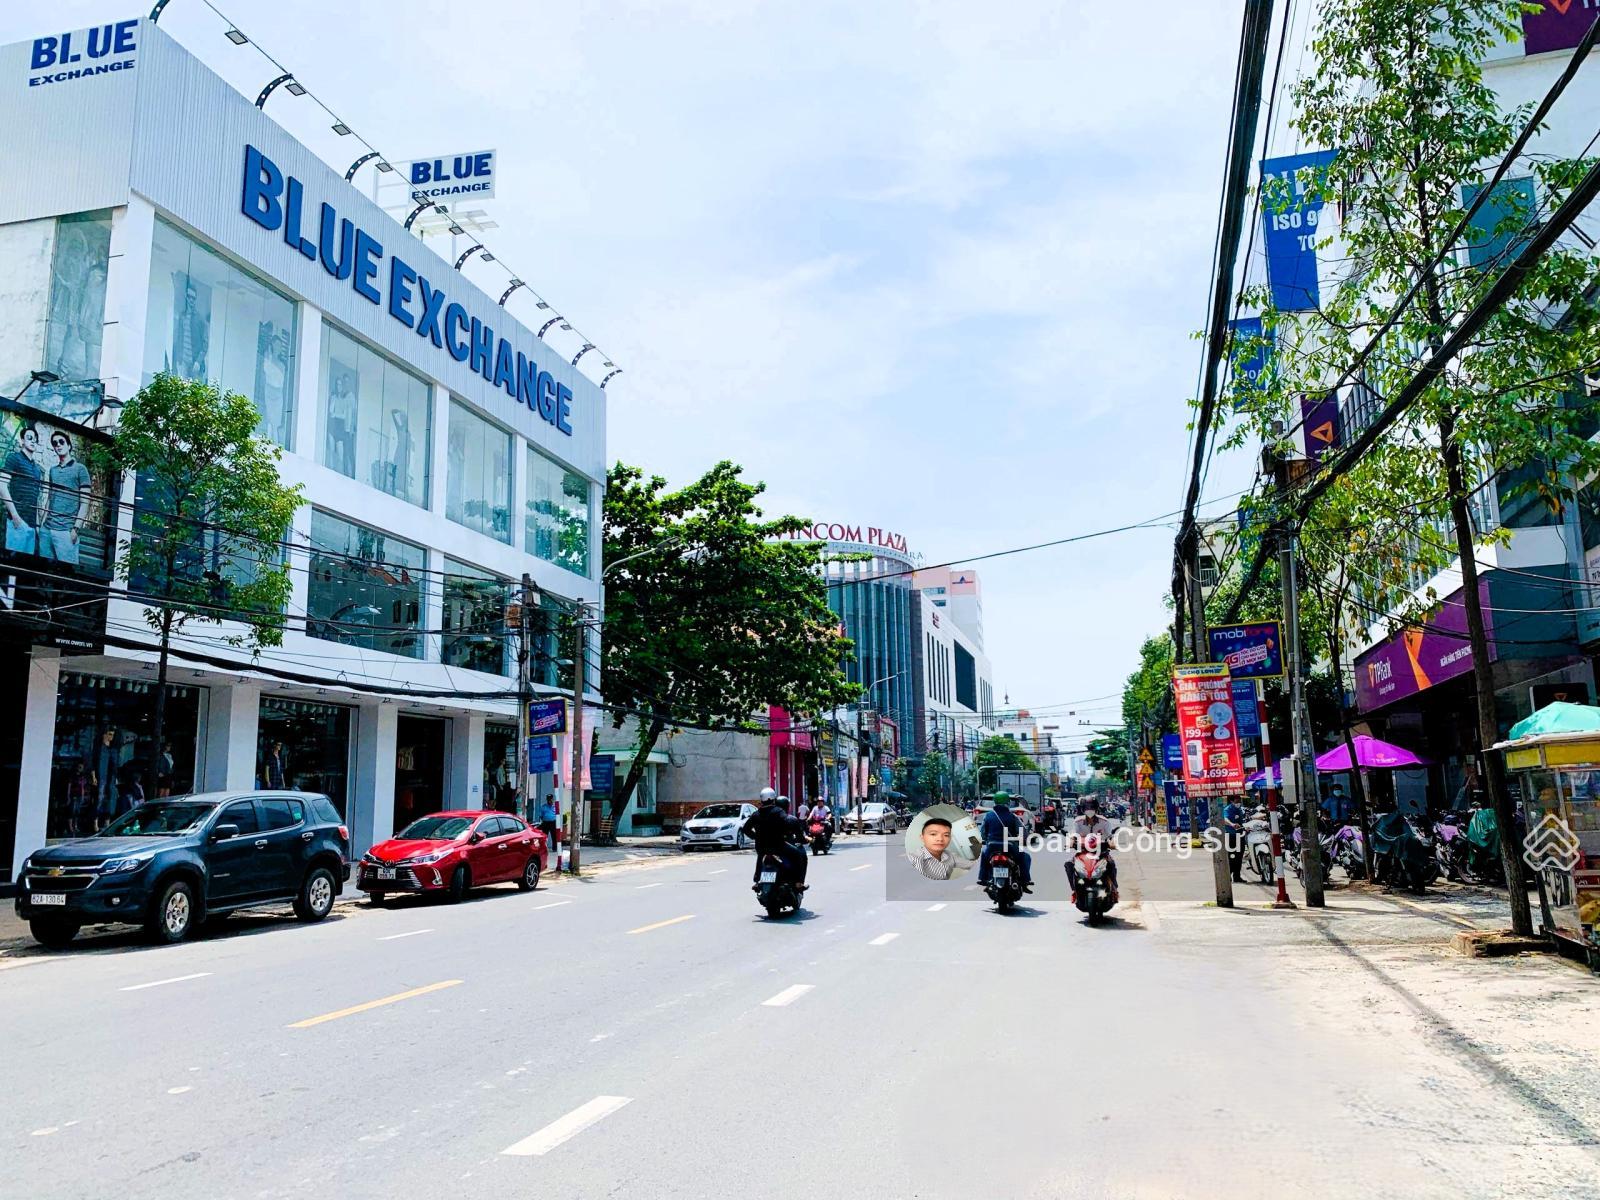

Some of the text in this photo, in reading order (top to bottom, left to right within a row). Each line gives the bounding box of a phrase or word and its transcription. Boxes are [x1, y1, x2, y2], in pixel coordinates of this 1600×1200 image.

[31, 20, 138, 70] BLUE
[29, 60, 135, 87] EXCHANGE
[412, 153, 492, 185] BLUE
[412, 182, 491, 199] EXCHANGE
[1273, 212, 1302, 231] ISO
[242, 143, 573, 436] BLUE EXCHANGE
[868, 527, 908, 554] PLAZA
